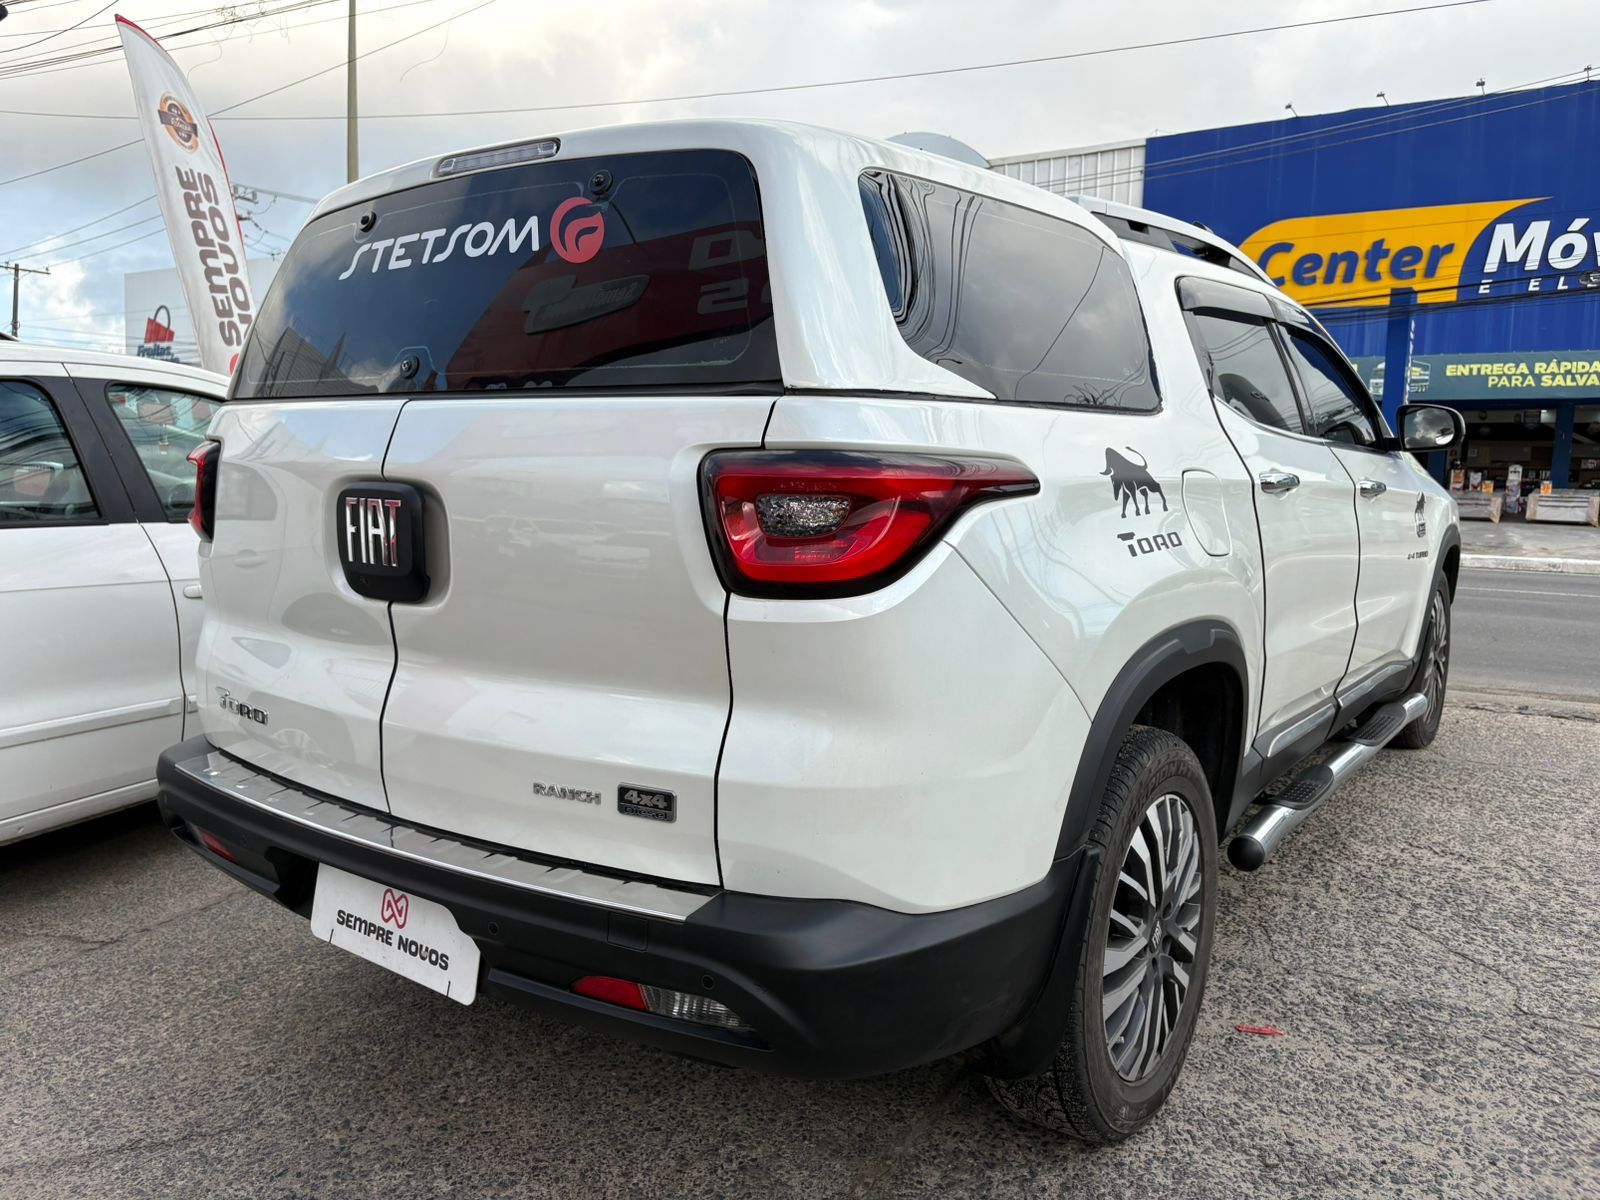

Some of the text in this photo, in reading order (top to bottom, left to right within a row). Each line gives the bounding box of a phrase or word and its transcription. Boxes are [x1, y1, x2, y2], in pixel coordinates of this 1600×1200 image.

[176, 165, 242, 347] SEMPRE
[338, 215, 540, 281] STETSOM
[1257, 238, 1456, 290] Center
[1483, 217, 1600, 274] Mó
[1446, 358, 1600, 377] ENTREGA RÁPIDA
[1487, 374, 1536, 389] PARA
[345, 497, 401, 567] FIAT
[1117, 531, 1182, 557] TORO
[533, 782, 602, 805] RANCH
[624, 789, 669, 809] 4x4
[336, 909, 394, 947] SEMPRE
